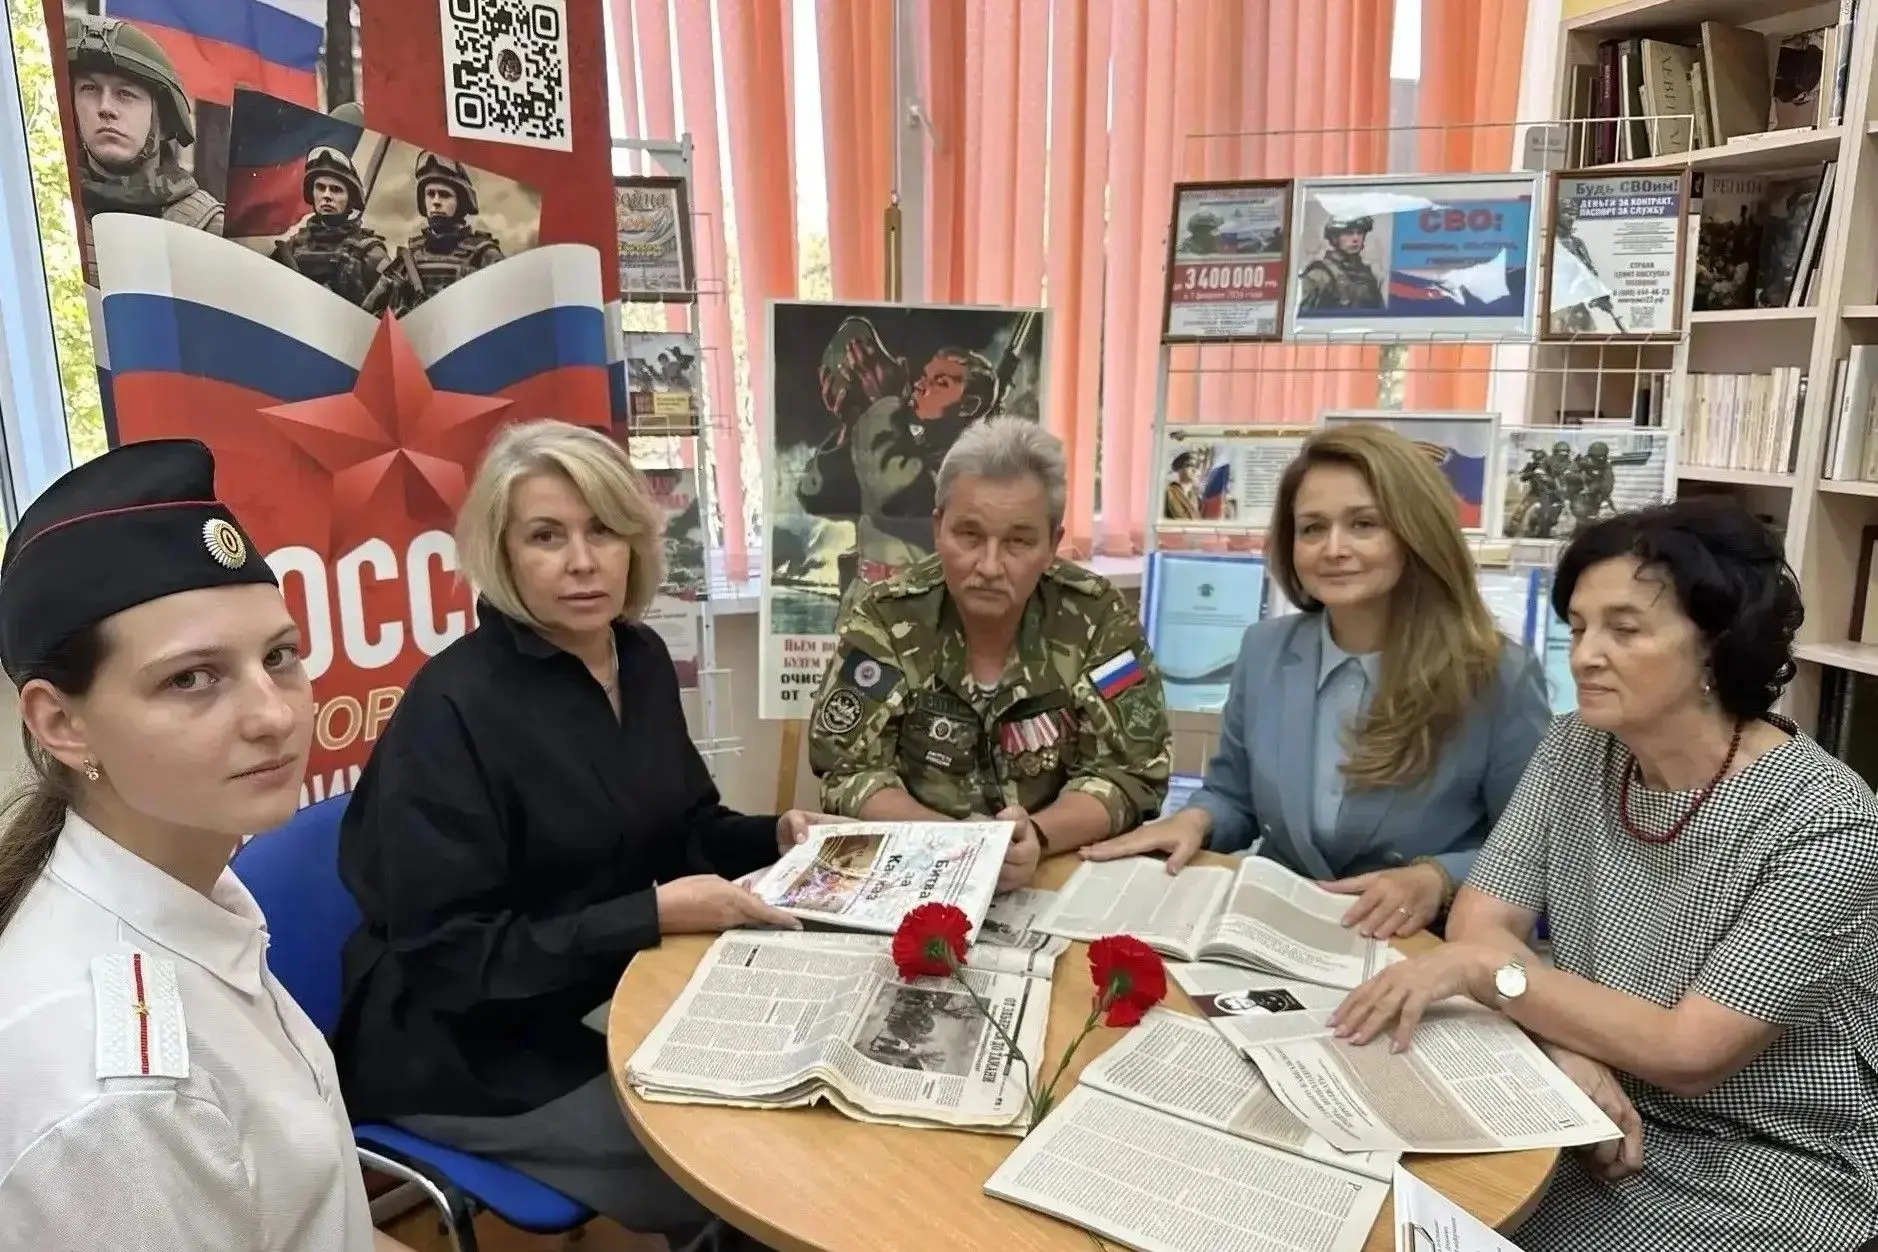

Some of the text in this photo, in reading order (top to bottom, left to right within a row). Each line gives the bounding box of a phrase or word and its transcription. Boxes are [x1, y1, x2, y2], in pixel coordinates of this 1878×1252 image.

[1575, 181, 1614, 196] Будь
[1579, 198, 1616, 208] ДЕНЬГИ
[1618, 198, 1629, 207] ЗА
[1578, 206, 1665, 217] ПАСПОРТ ЗА СЛУЖБУ
[1418, 207, 1505, 234] СВО:
[264, 529, 480, 682] ОСС
[781, 672, 823, 685] ОЧИС
[781, 689, 799, 701] ОТ
[919, 859, 950, 899] Битва
